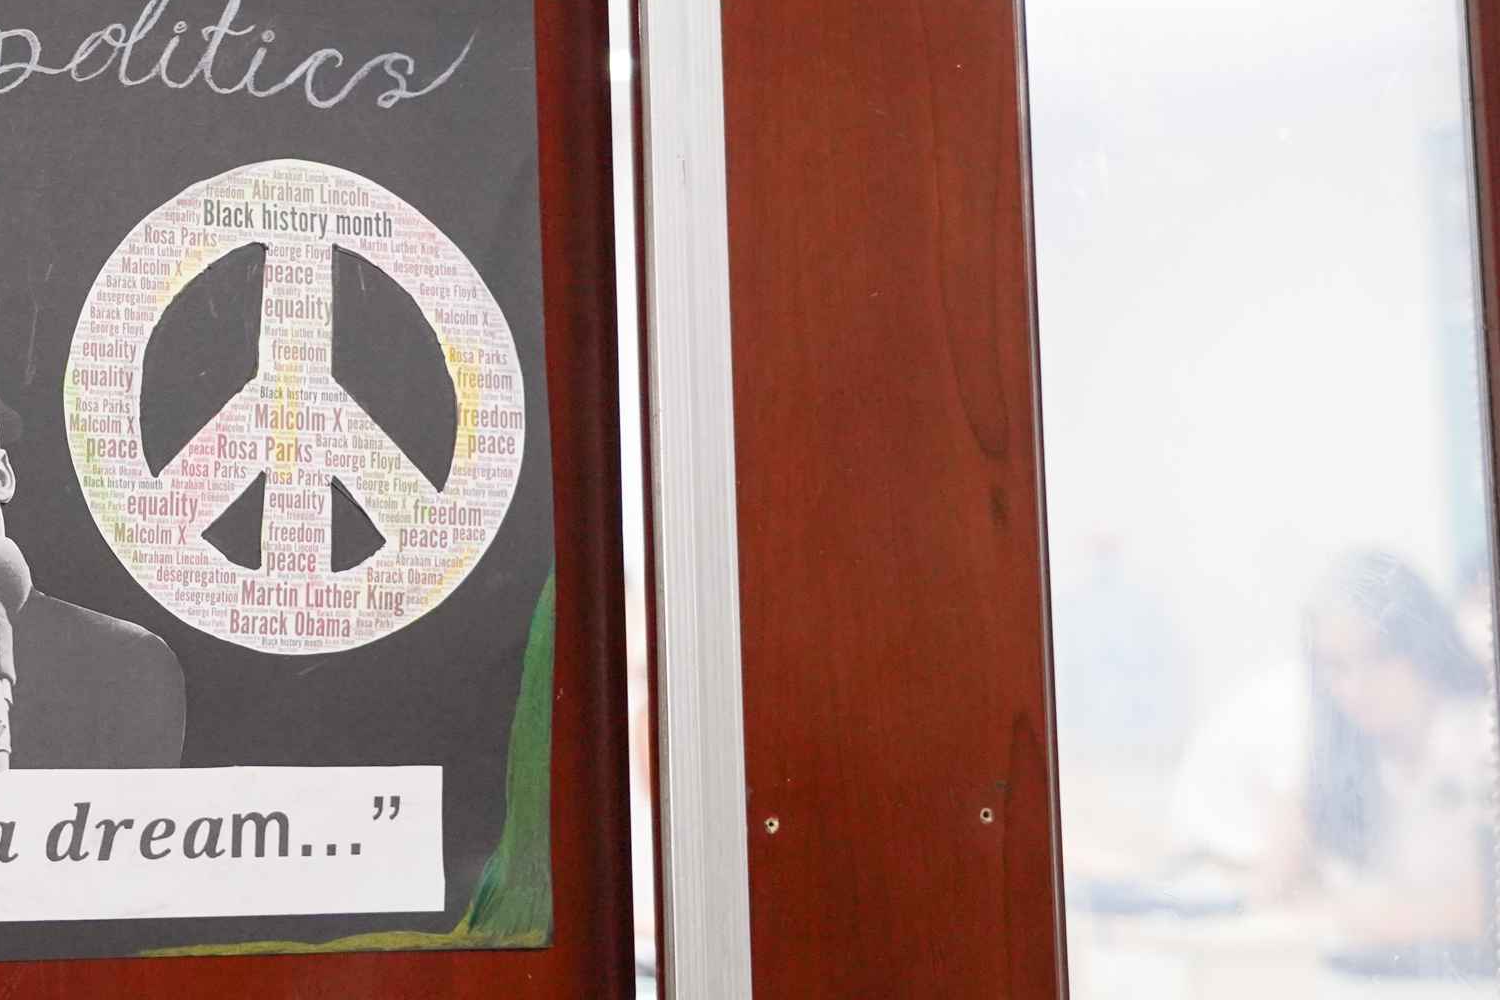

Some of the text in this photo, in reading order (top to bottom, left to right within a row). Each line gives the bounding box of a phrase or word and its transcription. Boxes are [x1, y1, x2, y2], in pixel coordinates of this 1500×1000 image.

[252, 180, 370, 207] Abraham Lincoln
[203, 199, 254, 229] Black
[262, 204, 328, 239] history
[336, 211, 393, 238] month
[144, 225, 218, 248] Rosa Parks
[121, 257, 183, 277] Malcolm X
[265, 264, 313, 288] peace
[264, 295, 332, 327] equality
[82, 339, 137, 363] equality
[272, 340, 326, 362] freedom
[449, 348, 508, 366] Rosa Parks
[72, 365, 133, 393] equality
[457, 367, 512, 390] freedom
[75, 397, 130, 415] Rosa Parks
[255, 403, 343, 433] Malcolm X
[458, 403, 523, 430] freedom
[69, 414, 136, 436] Malcolm X
[86, 437, 138, 463] peace
[188, 442, 215, 457] peace
[216, 433, 313, 464] Rosa Parks
[316, 434, 384, 451] Barack Obama
[468, 433, 516, 458] peace
[181, 459, 246, 480] Rosa Parks
[325, 450, 401, 474] George Floyd
[265, 467, 332, 488] Rosa Parks
[356, 476, 419, 496] George Floyd
[127, 491, 198, 524] equality
[269, 491, 325, 515] equality
[413, 499, 482, 527] freedom
[114, 522, 187, 546] Malcolm X
[269, 521, 325, 543] freedom
[400, 526, 486, 553] peace peace
[266, 551, 317, 576] peace
[156, 566, 237, 588] desegregation
[367, 568, 444, 586] Barack Obama
[241, 579, 406, 617] Martin Luther King
[230, 609, 350, 638] Barack Obama
